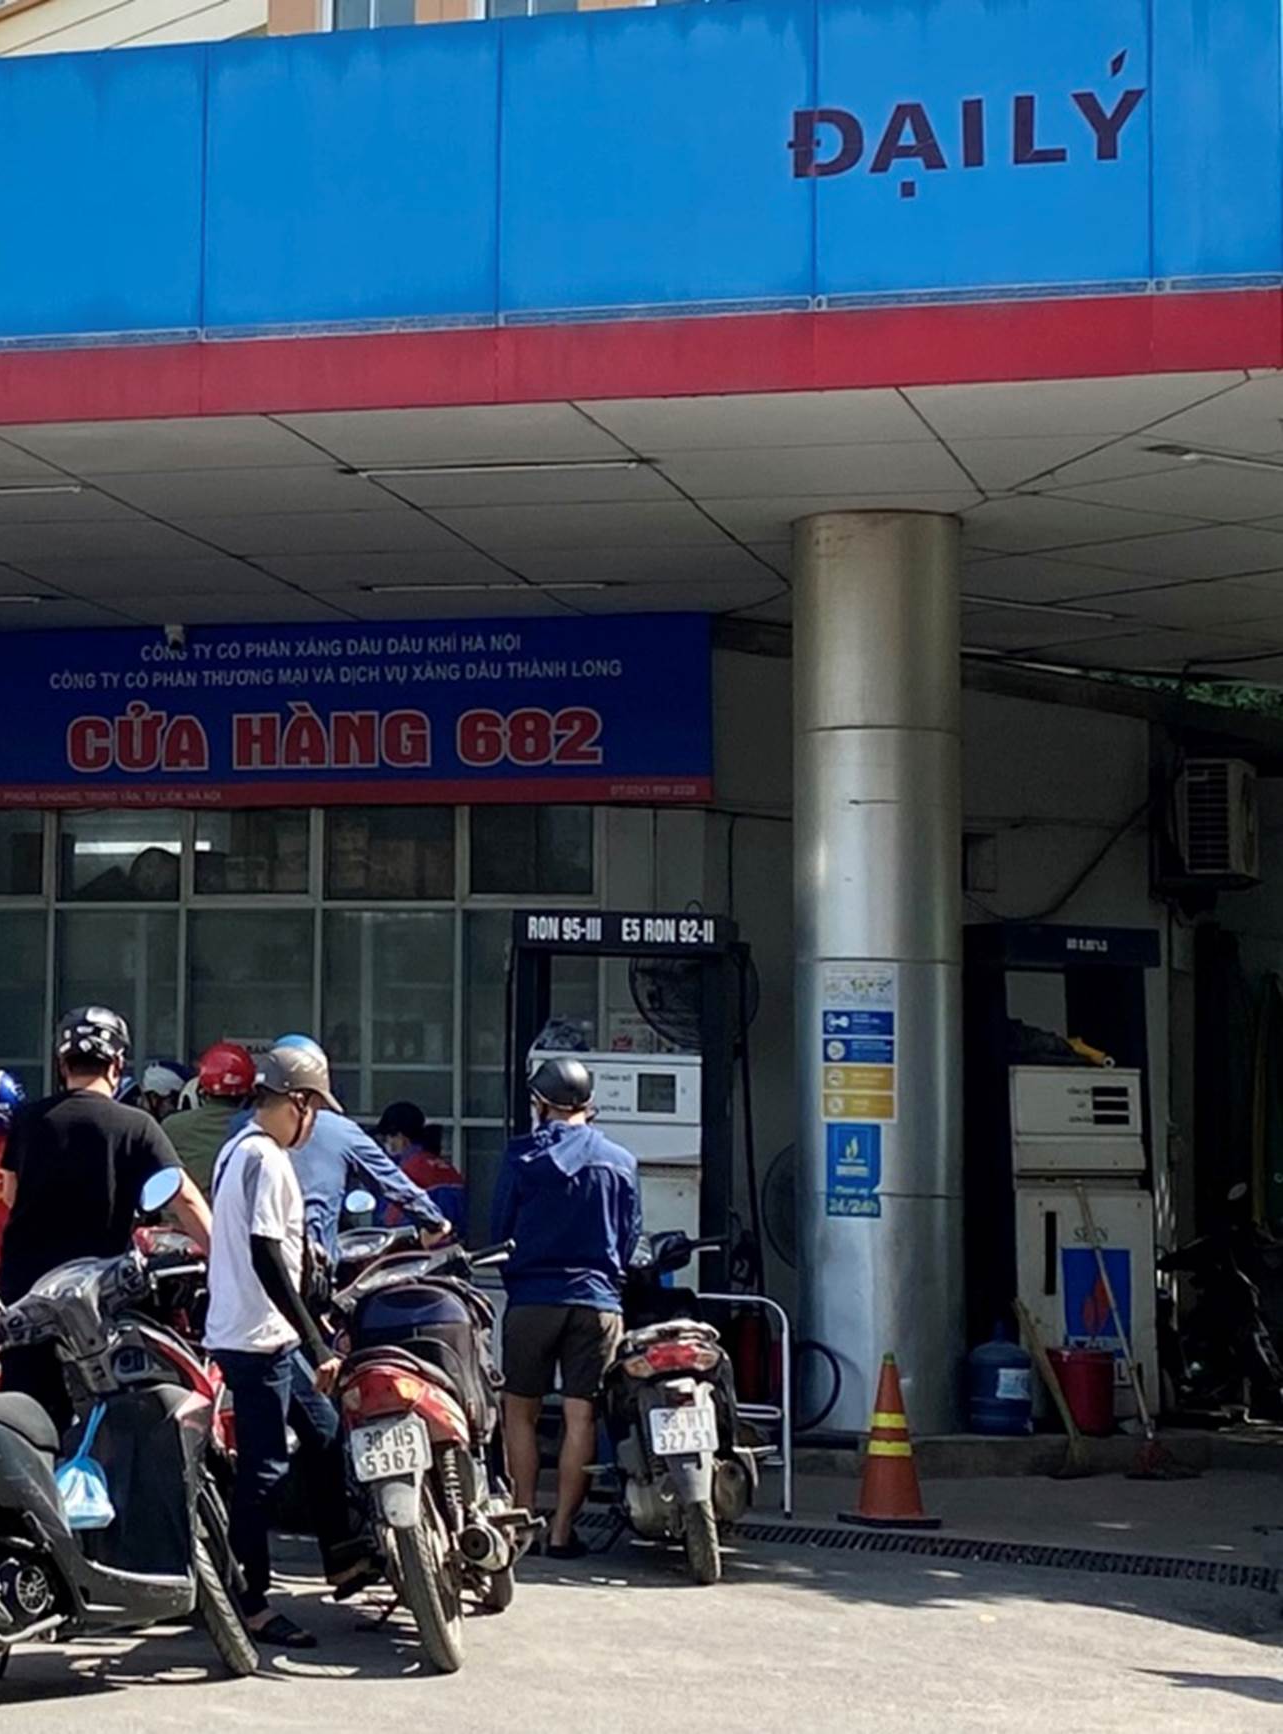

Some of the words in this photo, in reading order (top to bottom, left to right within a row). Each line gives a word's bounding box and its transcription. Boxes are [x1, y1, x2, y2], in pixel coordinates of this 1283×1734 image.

[192, 643, 213, 660] TY
[49, 668, 96, 690] CÔNG
[99, 672, 120, 688] TY
[571, 658, 622, 677] LONG
[66, 700, 210, 773] CỬA
[231, 701, 431, 772] HÀNG
[455, 707, 604, 769] 682
[527, 916, 559, 941] RON
[561, 917, 602, 941] 95-III
[621, 917, 641, 943] E5
[643, 918, 675, 943] RON
[678, 919, 715, 944] 92-II
[365, 1448, 419, 1475] 5362
